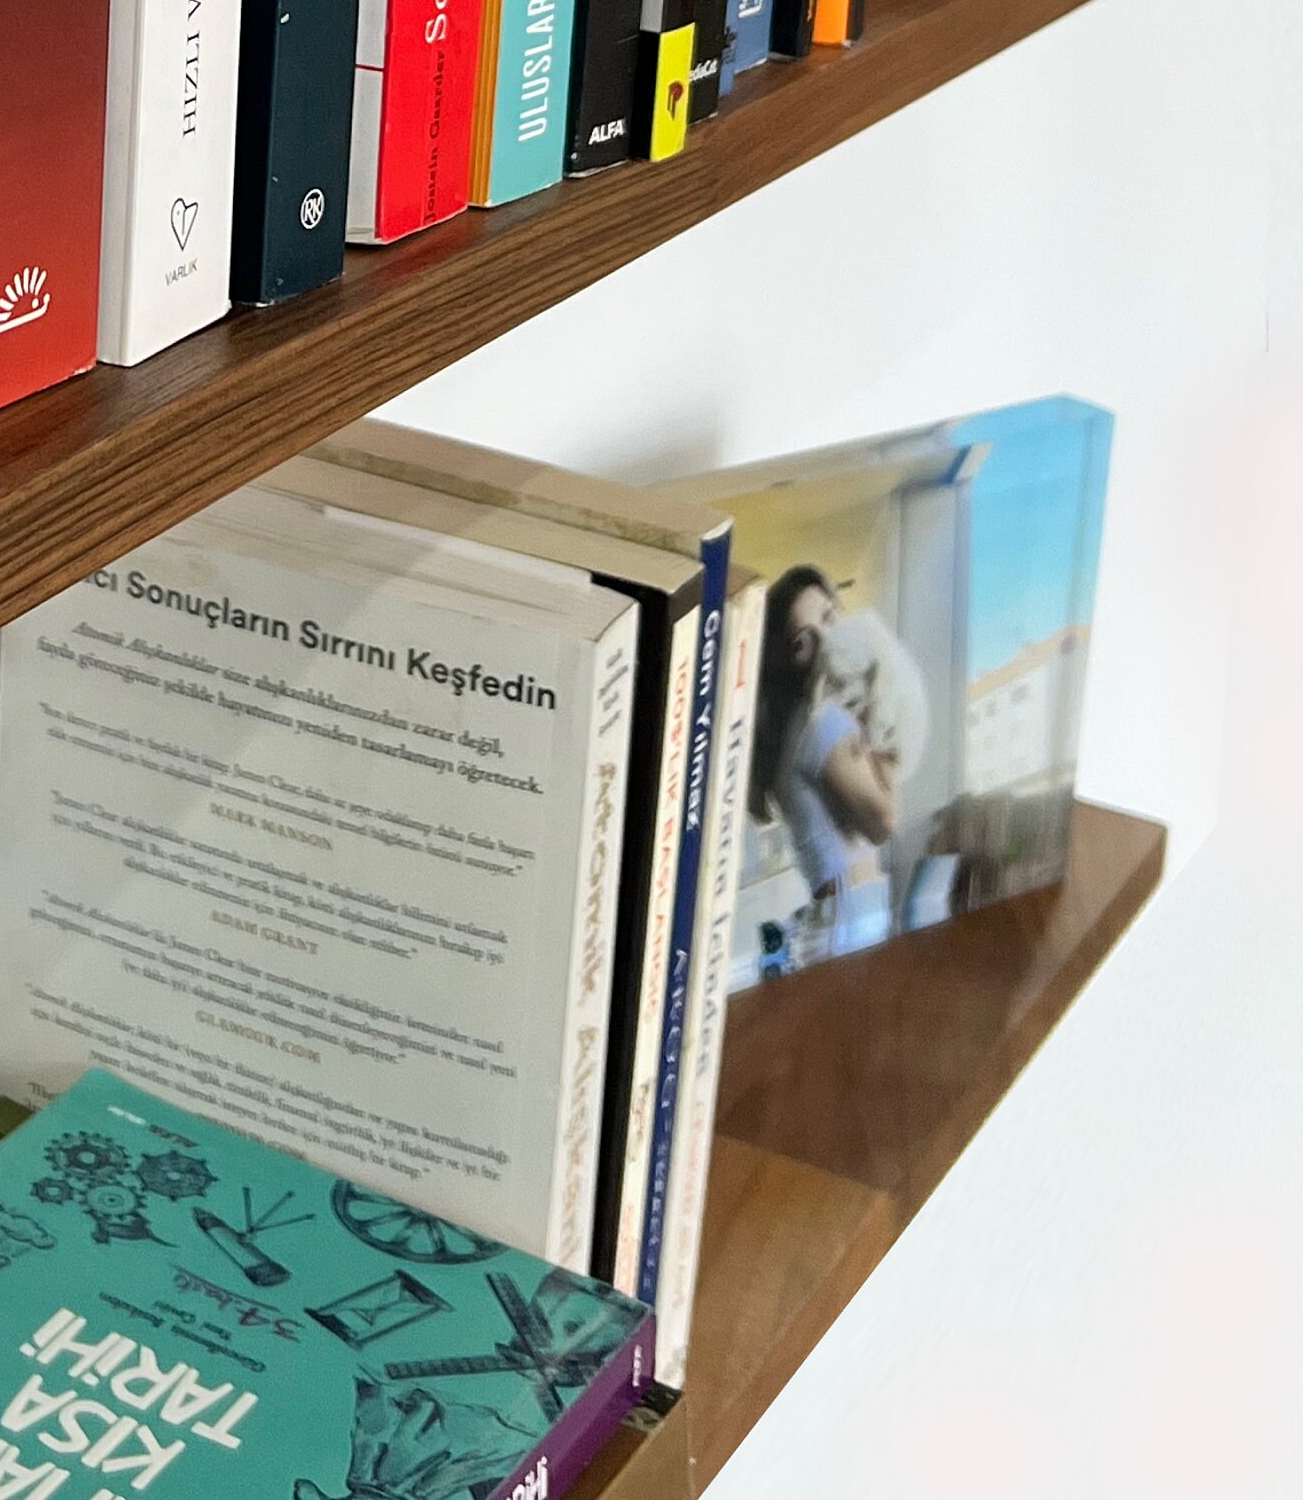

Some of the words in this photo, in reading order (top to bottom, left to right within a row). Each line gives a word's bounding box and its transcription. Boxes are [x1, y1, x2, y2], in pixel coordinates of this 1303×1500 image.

[183, 31, 200, 137] HIZLI
[588, 119, 626, 145] ALFA
[126, 571, 290, 641] Sonuçların
[299, 621, 396, 671] Sırrını
[407, 649, 557, 710] Keşfedin
[698, 610, 721, 696] Cem
[0, 1373, 185, 1490] KISA
